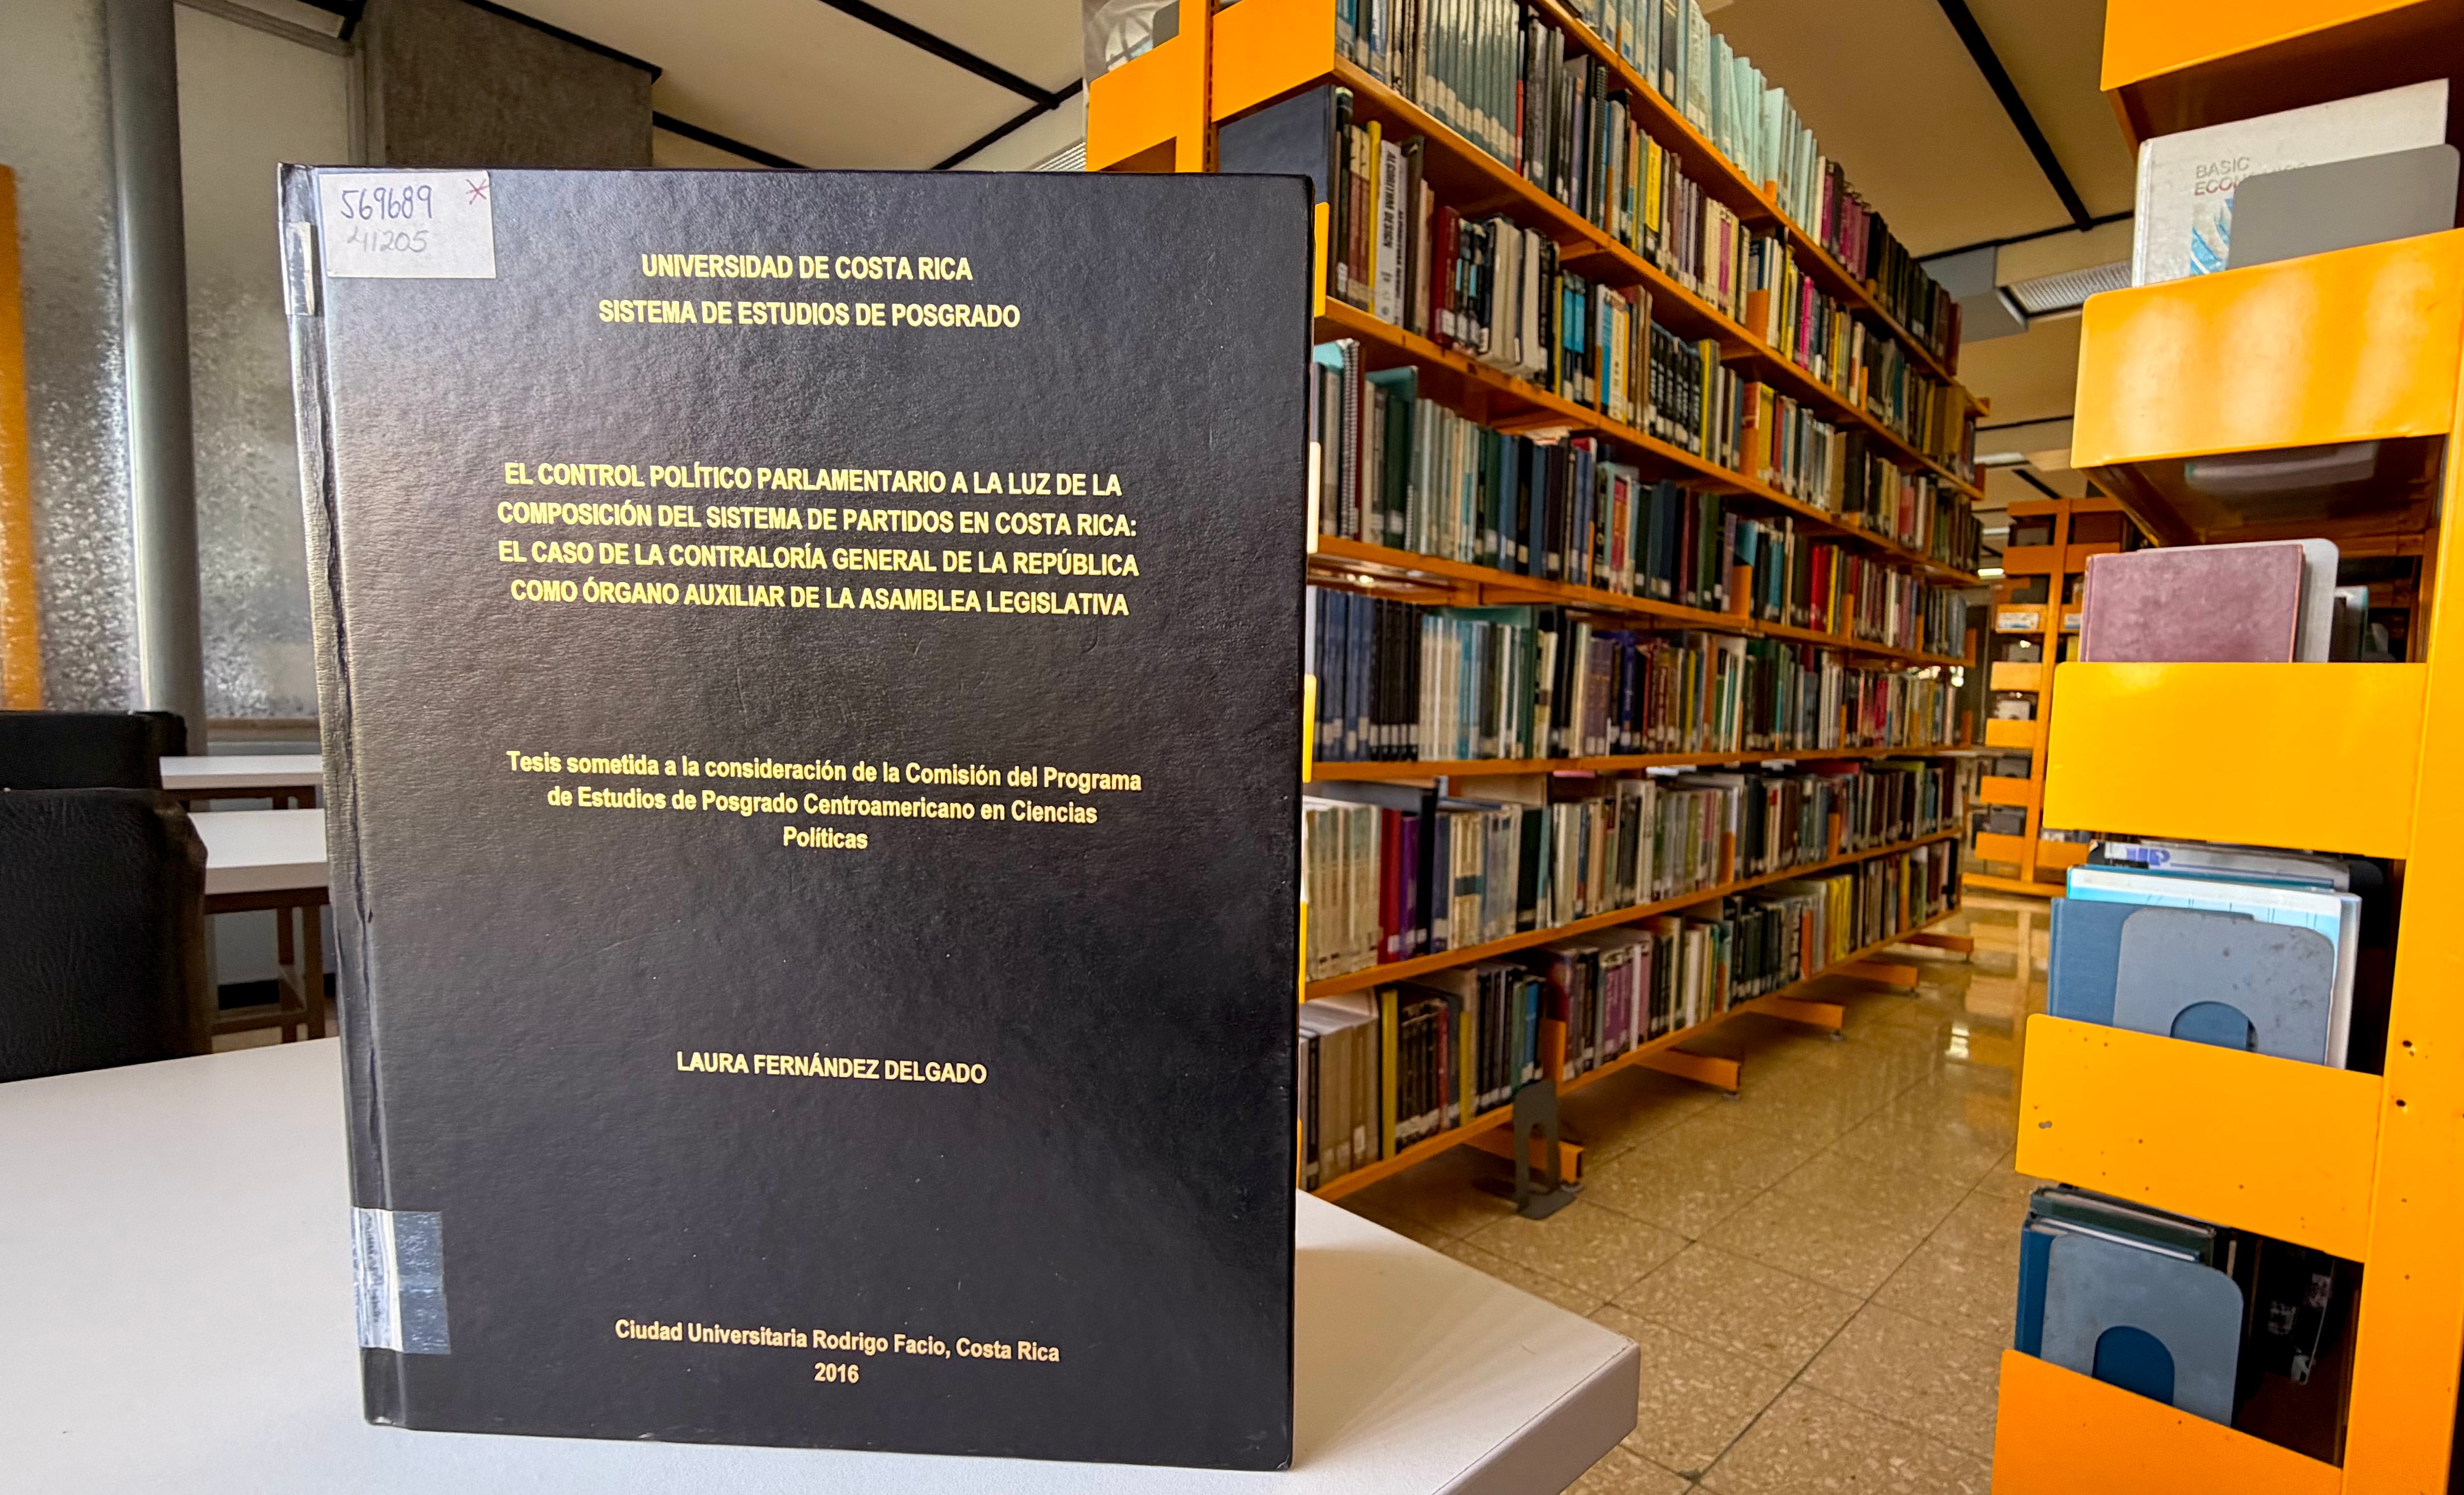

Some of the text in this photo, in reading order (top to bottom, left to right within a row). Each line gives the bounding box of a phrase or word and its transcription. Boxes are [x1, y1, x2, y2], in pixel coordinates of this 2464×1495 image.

[2196, 156, 2250, 179] BASIC
[341, 184, 432, 220] 569689
[643, 254, 973, 281] UNIVERSIDAD DE COSTA RICA
[599, 299, 1020, 328] SISTEMA DE ESTUDIOS DE POSGRADO
[505, 462, 1122, 496] EL CONTROL POLÍTICO PARLAMENTARIO A LA LUZ DE LA
[497, 500, 1137, 537] COMPOSICIÓN DEL SISTEMA DE PARTIDOS EN COSTA RICA:
[498, 540, 1140, 577] EL CASO DE LA CONTRALORÍA GENERAL DE LA REPÚBLICA
[510, 576, 1129, 616] COMO ÓRGANO AUXILIAR DE LA ASAMBLEA LEGISLATIVA
[506, 750, 1142, 794] Tesis sometida a la consideración de la Comisión del Programa
[547, 785, 1097, 824] de Estudios de Posgrado Centroamericano en Ciencias
[783, 826, 868, 849] Políticas
[678, 1052, 986, 1084] LAURA FERNÁNDEZ DELGADO
[615, 1318, 1060, 1362] Ciudad Universitaria Rodrigo Facio, Costa Rica
[814, 1362, 859, 1383] 2016
